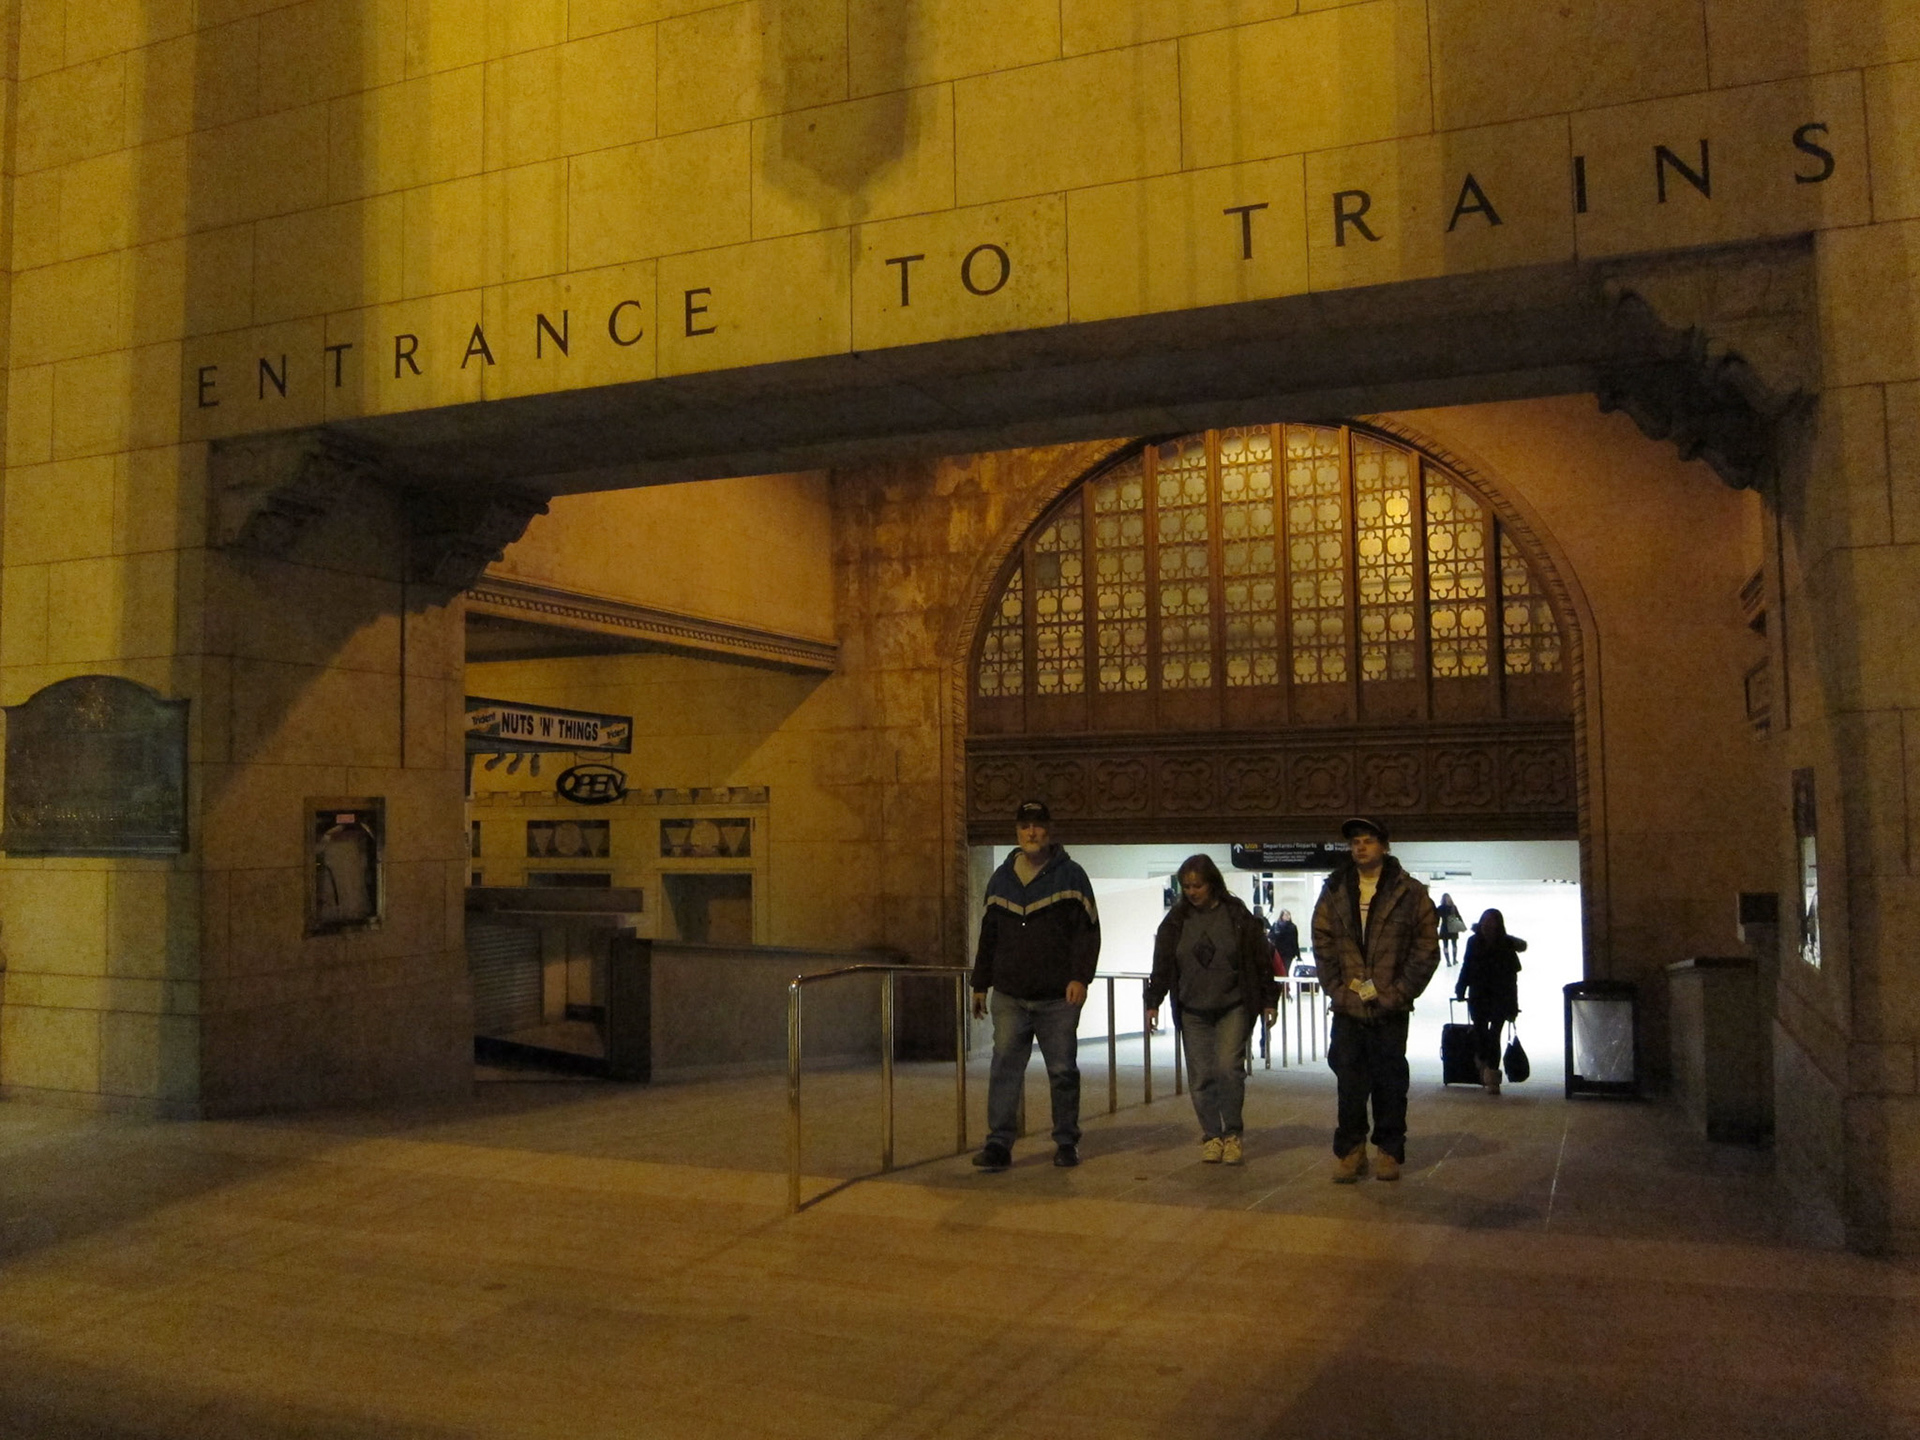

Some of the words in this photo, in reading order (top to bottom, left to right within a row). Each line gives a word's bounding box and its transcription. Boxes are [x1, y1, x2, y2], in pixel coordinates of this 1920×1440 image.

[198, 287, 717, 408] ENTRANCE
[885, 243, 1011, 307] TO
[1223, 122, 1835, 259] TRAINS
[501, 711, 534, 735] NUTS
[558, 719, 598, 741] THINGS
[558, 768, 627, 800] OPEN
